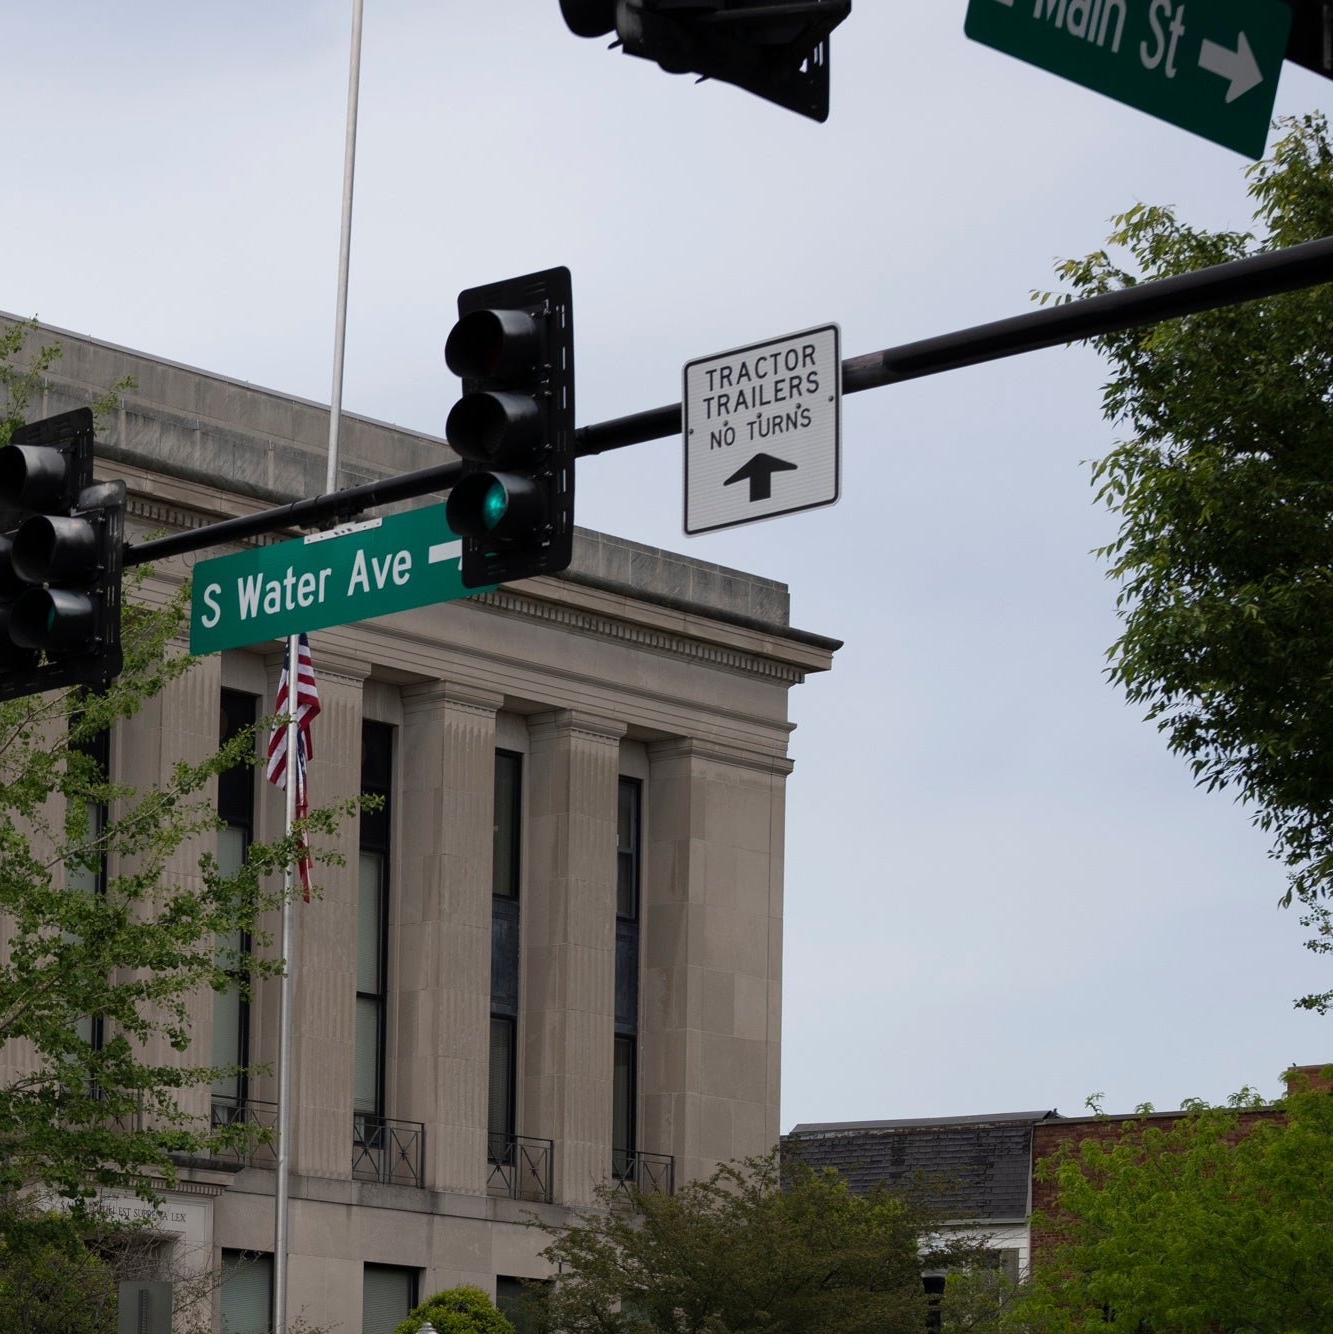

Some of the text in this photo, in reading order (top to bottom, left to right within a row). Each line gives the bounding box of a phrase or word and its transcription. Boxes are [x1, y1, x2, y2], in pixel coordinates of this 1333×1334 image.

[1140, 0, 1186, 79] St
[705, 344, 816, 392] TRACTOR
[703, 371, 819, 420] TRAILERS
[710, 408, 812, 450] NO TURNS
[201, 549, 413, 629] S Water Ave
[133, 1207, 169, 1221] SUPREA
[171, 1211, 187, 1223] LEX
